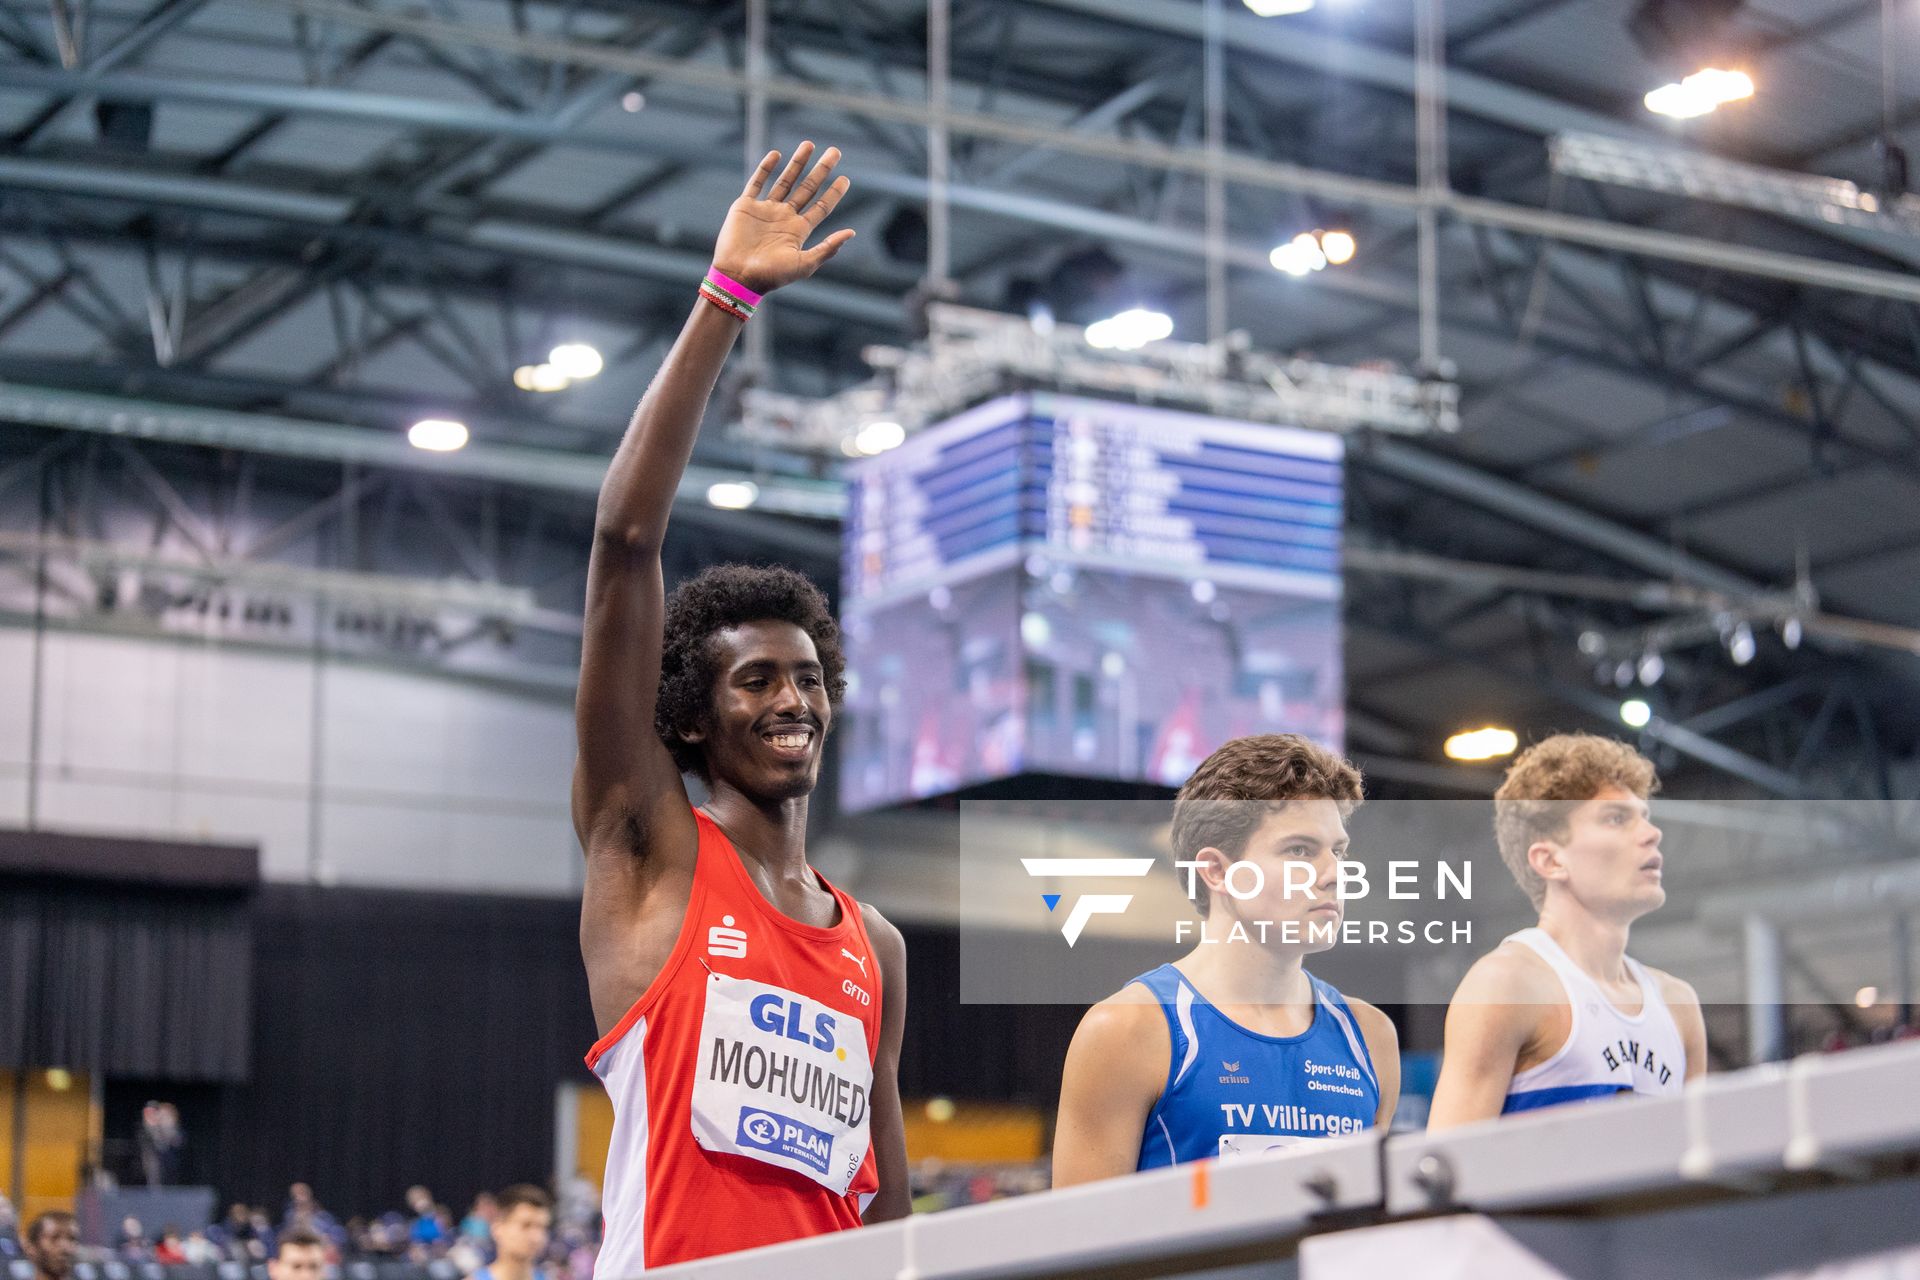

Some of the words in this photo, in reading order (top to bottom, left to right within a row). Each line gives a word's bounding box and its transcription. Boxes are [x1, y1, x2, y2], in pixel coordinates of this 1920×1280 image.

[842, 979, 870, 1007] GfTD
[709, 1037, 866, 1129] MOHUMED
[1304, 1059, 1361, 1081] Sport-Weiß
[1308, 1080, 1363, 1097] Obereschach
[1221, 1104, 1255, 1128] TV
[1262, 1104, 1364, 1138] Villingen
[783, 1124, 830, 1160] PLAN
[782, 1143, 826, 1170] INTERNATIONAL
